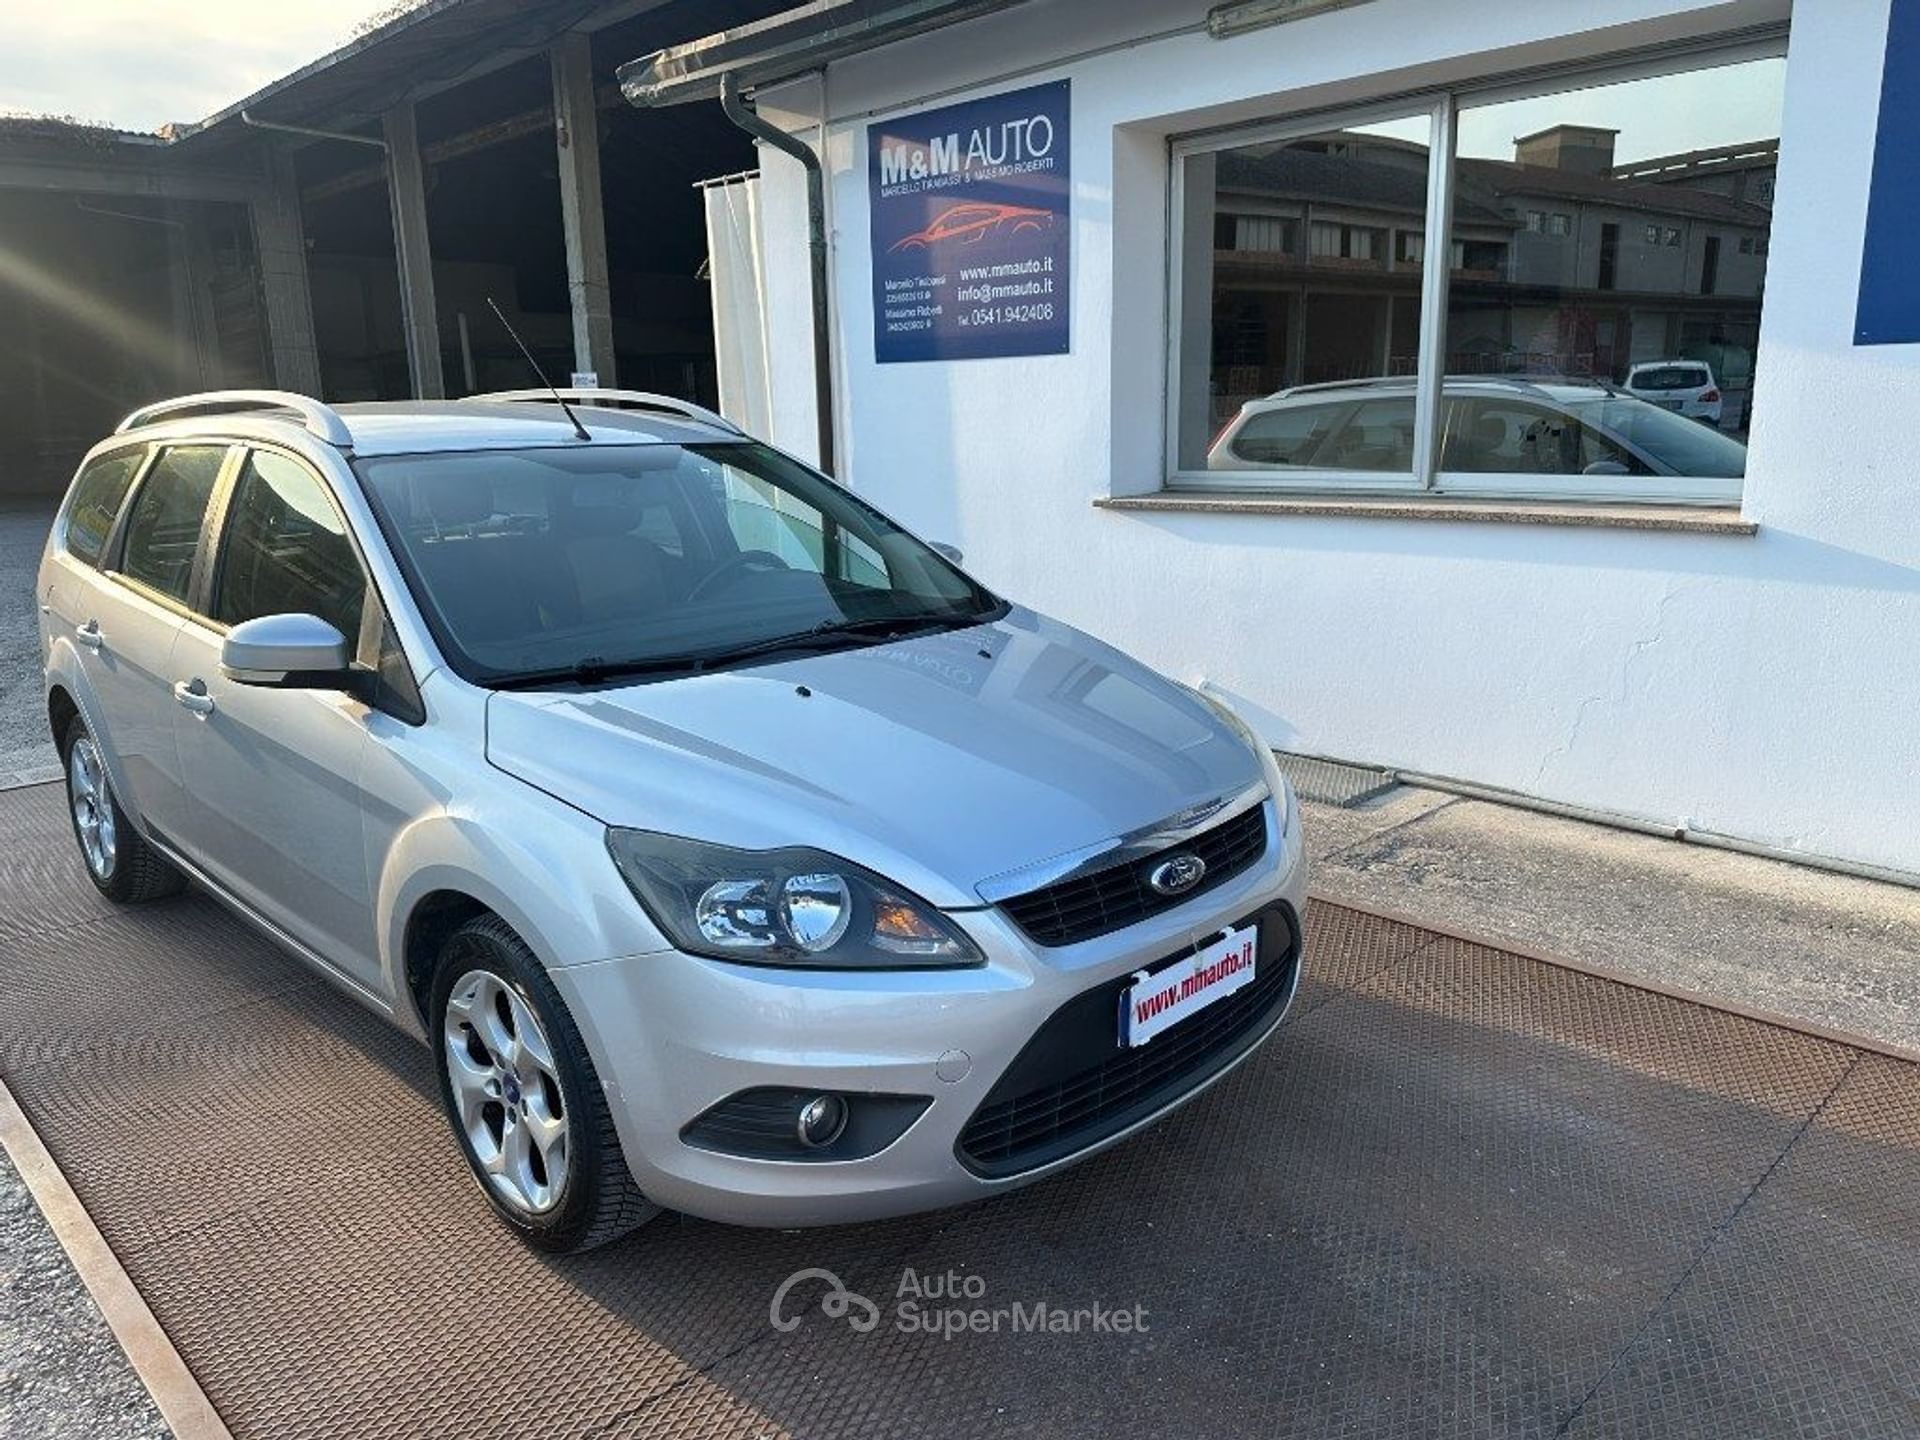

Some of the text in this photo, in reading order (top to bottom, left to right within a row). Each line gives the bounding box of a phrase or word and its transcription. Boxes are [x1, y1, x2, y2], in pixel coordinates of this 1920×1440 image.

[880, 115, 1053, 186] M&M AUTO
[1014, 157, 1053, 174] ROBERTI
[960, 256, 1053, 281] www.mmauto.it
[958, 277, 1053, 303] info@mmauto.it
[972, 303, 1053, 326] 0541.942408
[1136, 942, 1253, 1025] www.mmauto.it
